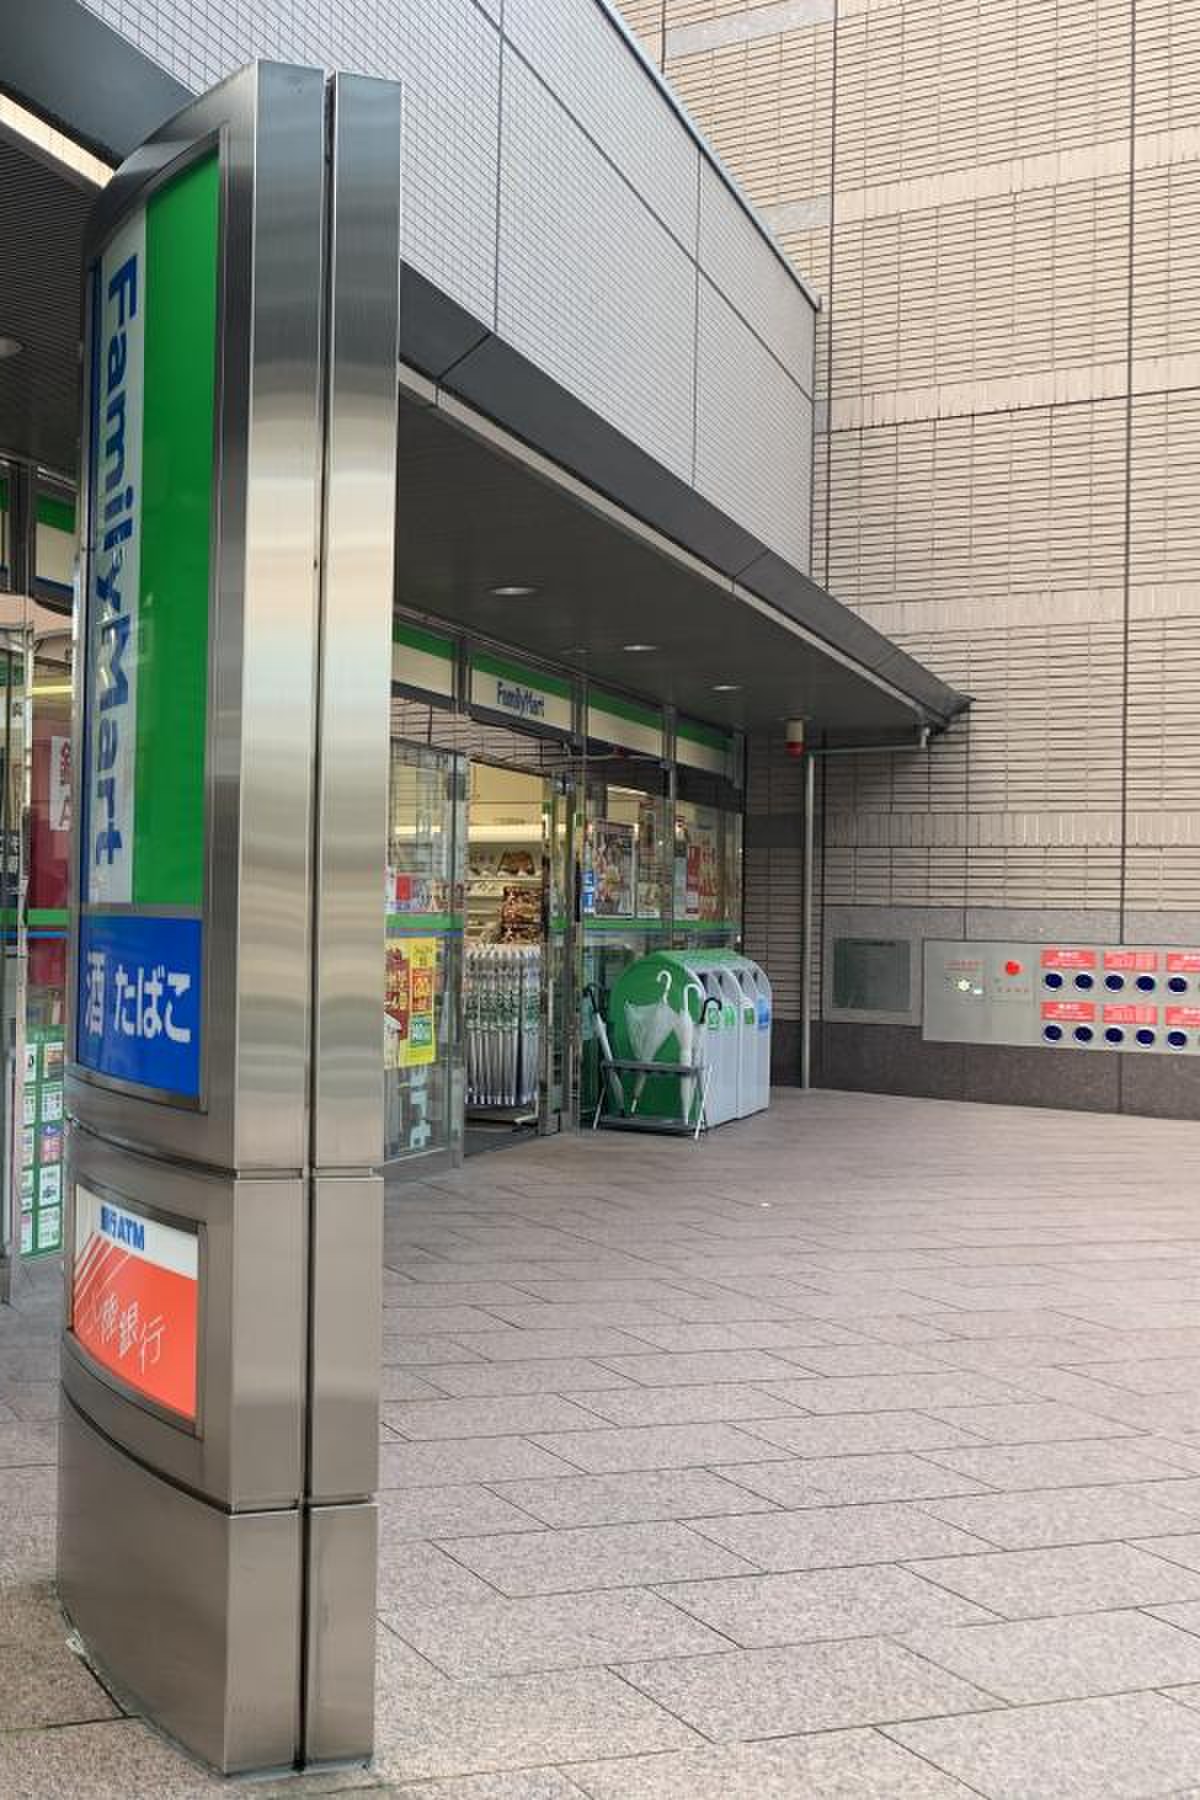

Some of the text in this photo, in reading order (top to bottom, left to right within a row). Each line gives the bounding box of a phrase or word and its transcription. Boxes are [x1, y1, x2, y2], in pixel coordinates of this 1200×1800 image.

[96, 252, 140, 867] FamilyMart
[113, 963, 192, 1044] たばこ
